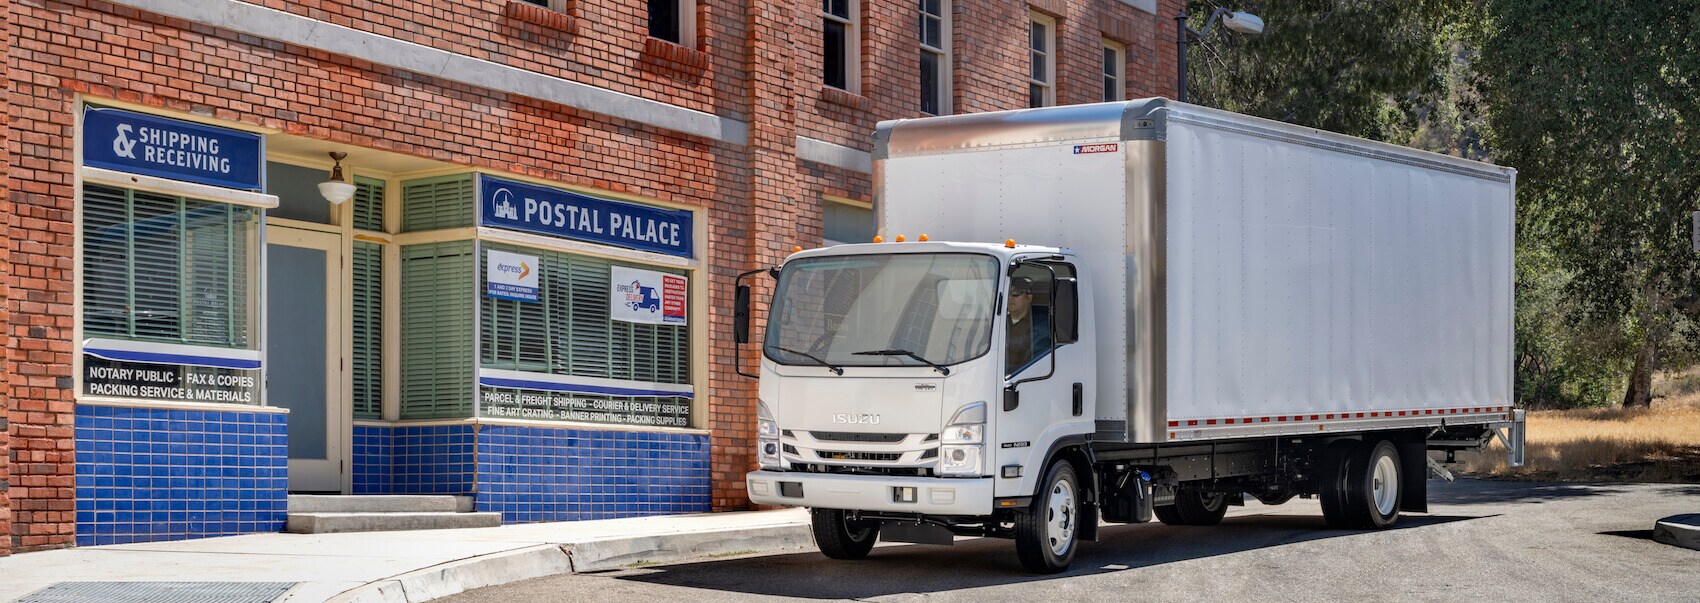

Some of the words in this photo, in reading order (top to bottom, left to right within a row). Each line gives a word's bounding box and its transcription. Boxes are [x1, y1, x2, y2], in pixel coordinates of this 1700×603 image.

[113, 123, 137, 159] &
[139, 127, 219, 155] SHIPPING
[145, 145, 231, 174] RECEIVING
[524, 198, 603, 234] POSTAL
[610, 213, 681, 246] PALACE
[497, 263, 522, 274] express
[617, 284, 634, 293] EXPRESS
[90, 367, 134, 380] NOTARY
[136, 370, 174, 382] PUBLIC
[186, 373, 206, 384] FAX
[208, 375, 215, 385] &
[217, 375, 254, 387] COPIES
[90, 383, 138, 396] PACKING
[140, 386, 184, 398] SERVICE
[186, 389, 193, 399] &
[196, 389, 251, 402] MATERIALS
[485, 393, 514, 403] PARCEL
[515, 395, 520, 403] &
[522, 395, 552, 405] FREIGHT
[554, 397, 586, 408] SHIPPING
[594, 400, 623, 410] COURIER
[624, 402, 629, 410] &
[630, 402, 660, 413] DELIVERY
[662, 404, 689, 414] SERVICE
[487, 406, 505, 416] FINE
[506, 407, 520, 416] ART
[522, 408, 553, 418] CRATING
[561, 411, 589, 420] BANNER
[590, 412, 622, 422] PRINTING
[627, 415, 655, 424] PACKING
[656, 416, 687, 426] SUPPLIES
[832, 413, 880, 424] ISUZU
